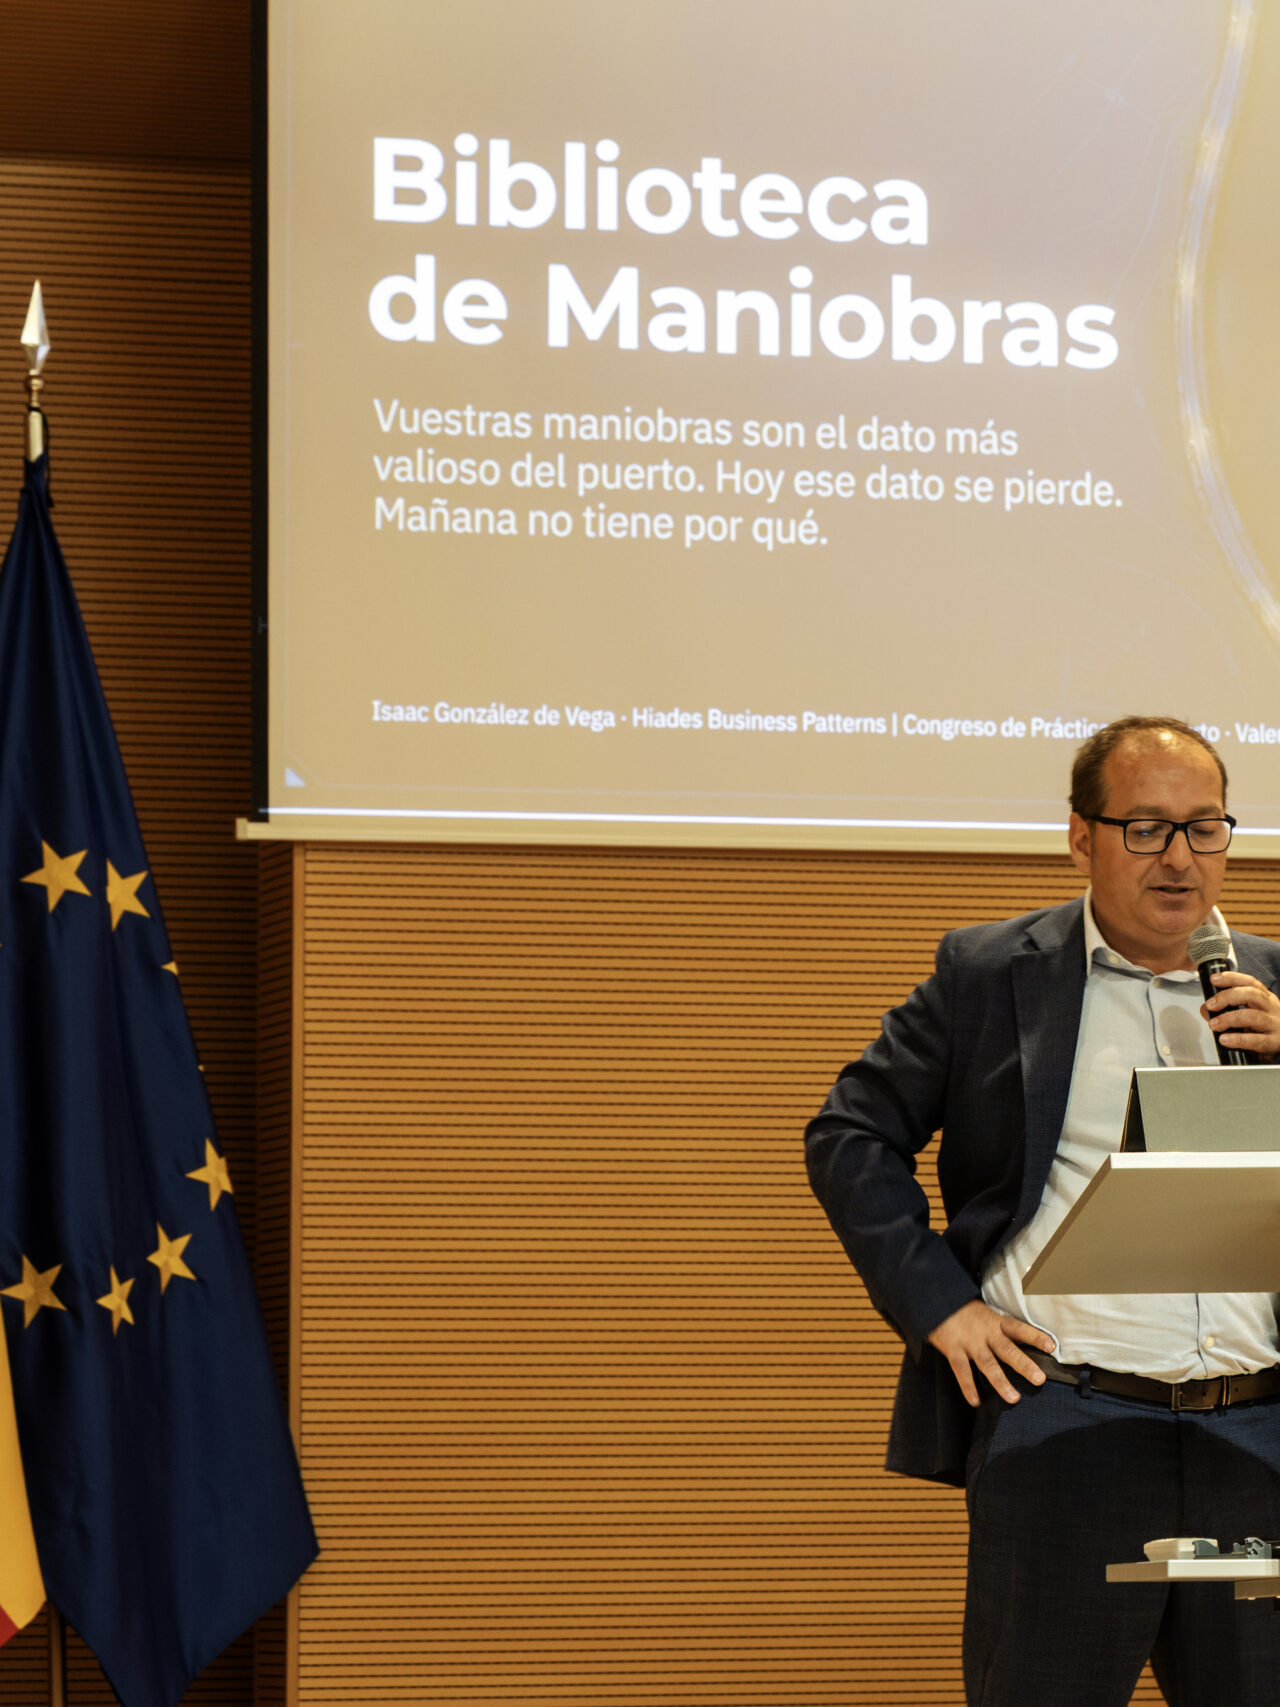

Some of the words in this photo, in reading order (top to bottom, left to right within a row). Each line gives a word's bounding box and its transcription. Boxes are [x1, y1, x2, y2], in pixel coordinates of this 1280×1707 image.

[372, 132, 929, 246] Biblioteca
[368, 253, 508, 346] de
[547, 264, 1120, 371] Maniobras
[373, 398, 532, 438] Vuestras
[543, 406, 733, 445] maniobras
[742, 420, 805, 447] son
[816, 414, 847, 449] el
[858, 416, 936, 452] dato
[946, 419, 1018, 456] más
[373, 449, 501, 486] valioso
[510, 452, 566, 488] del
[577, 459, 705, 497] puerto.
[716, 459, 785, 503] Hoy
[794, 470, 857, 498] ese
[866, 464, 945, 502] dato
[954, 476, 995, 504] se
[1004, 469, 1123, 512] pierde.
[374, 496, 518, 535] Mañana
[527, 510, 573, 538] no
[582, 504, 674, 540] tiene
[684, 514, 743, 549] por
[752, 512, 829, 552] qué.
[372, 700, 430, 723] Isaac
[433, 701, 530, 727] González
[533, 704, 561, 727] de
[564, 705, 616, 731] Vega
[632, 706, 704, 731] Hiades
[707, 707, 798, 733] Business
[802, 710, 888, 735] Patterns
[902, 713, 998, 741] Congreso
[1001, 715, 1027, 739] de
